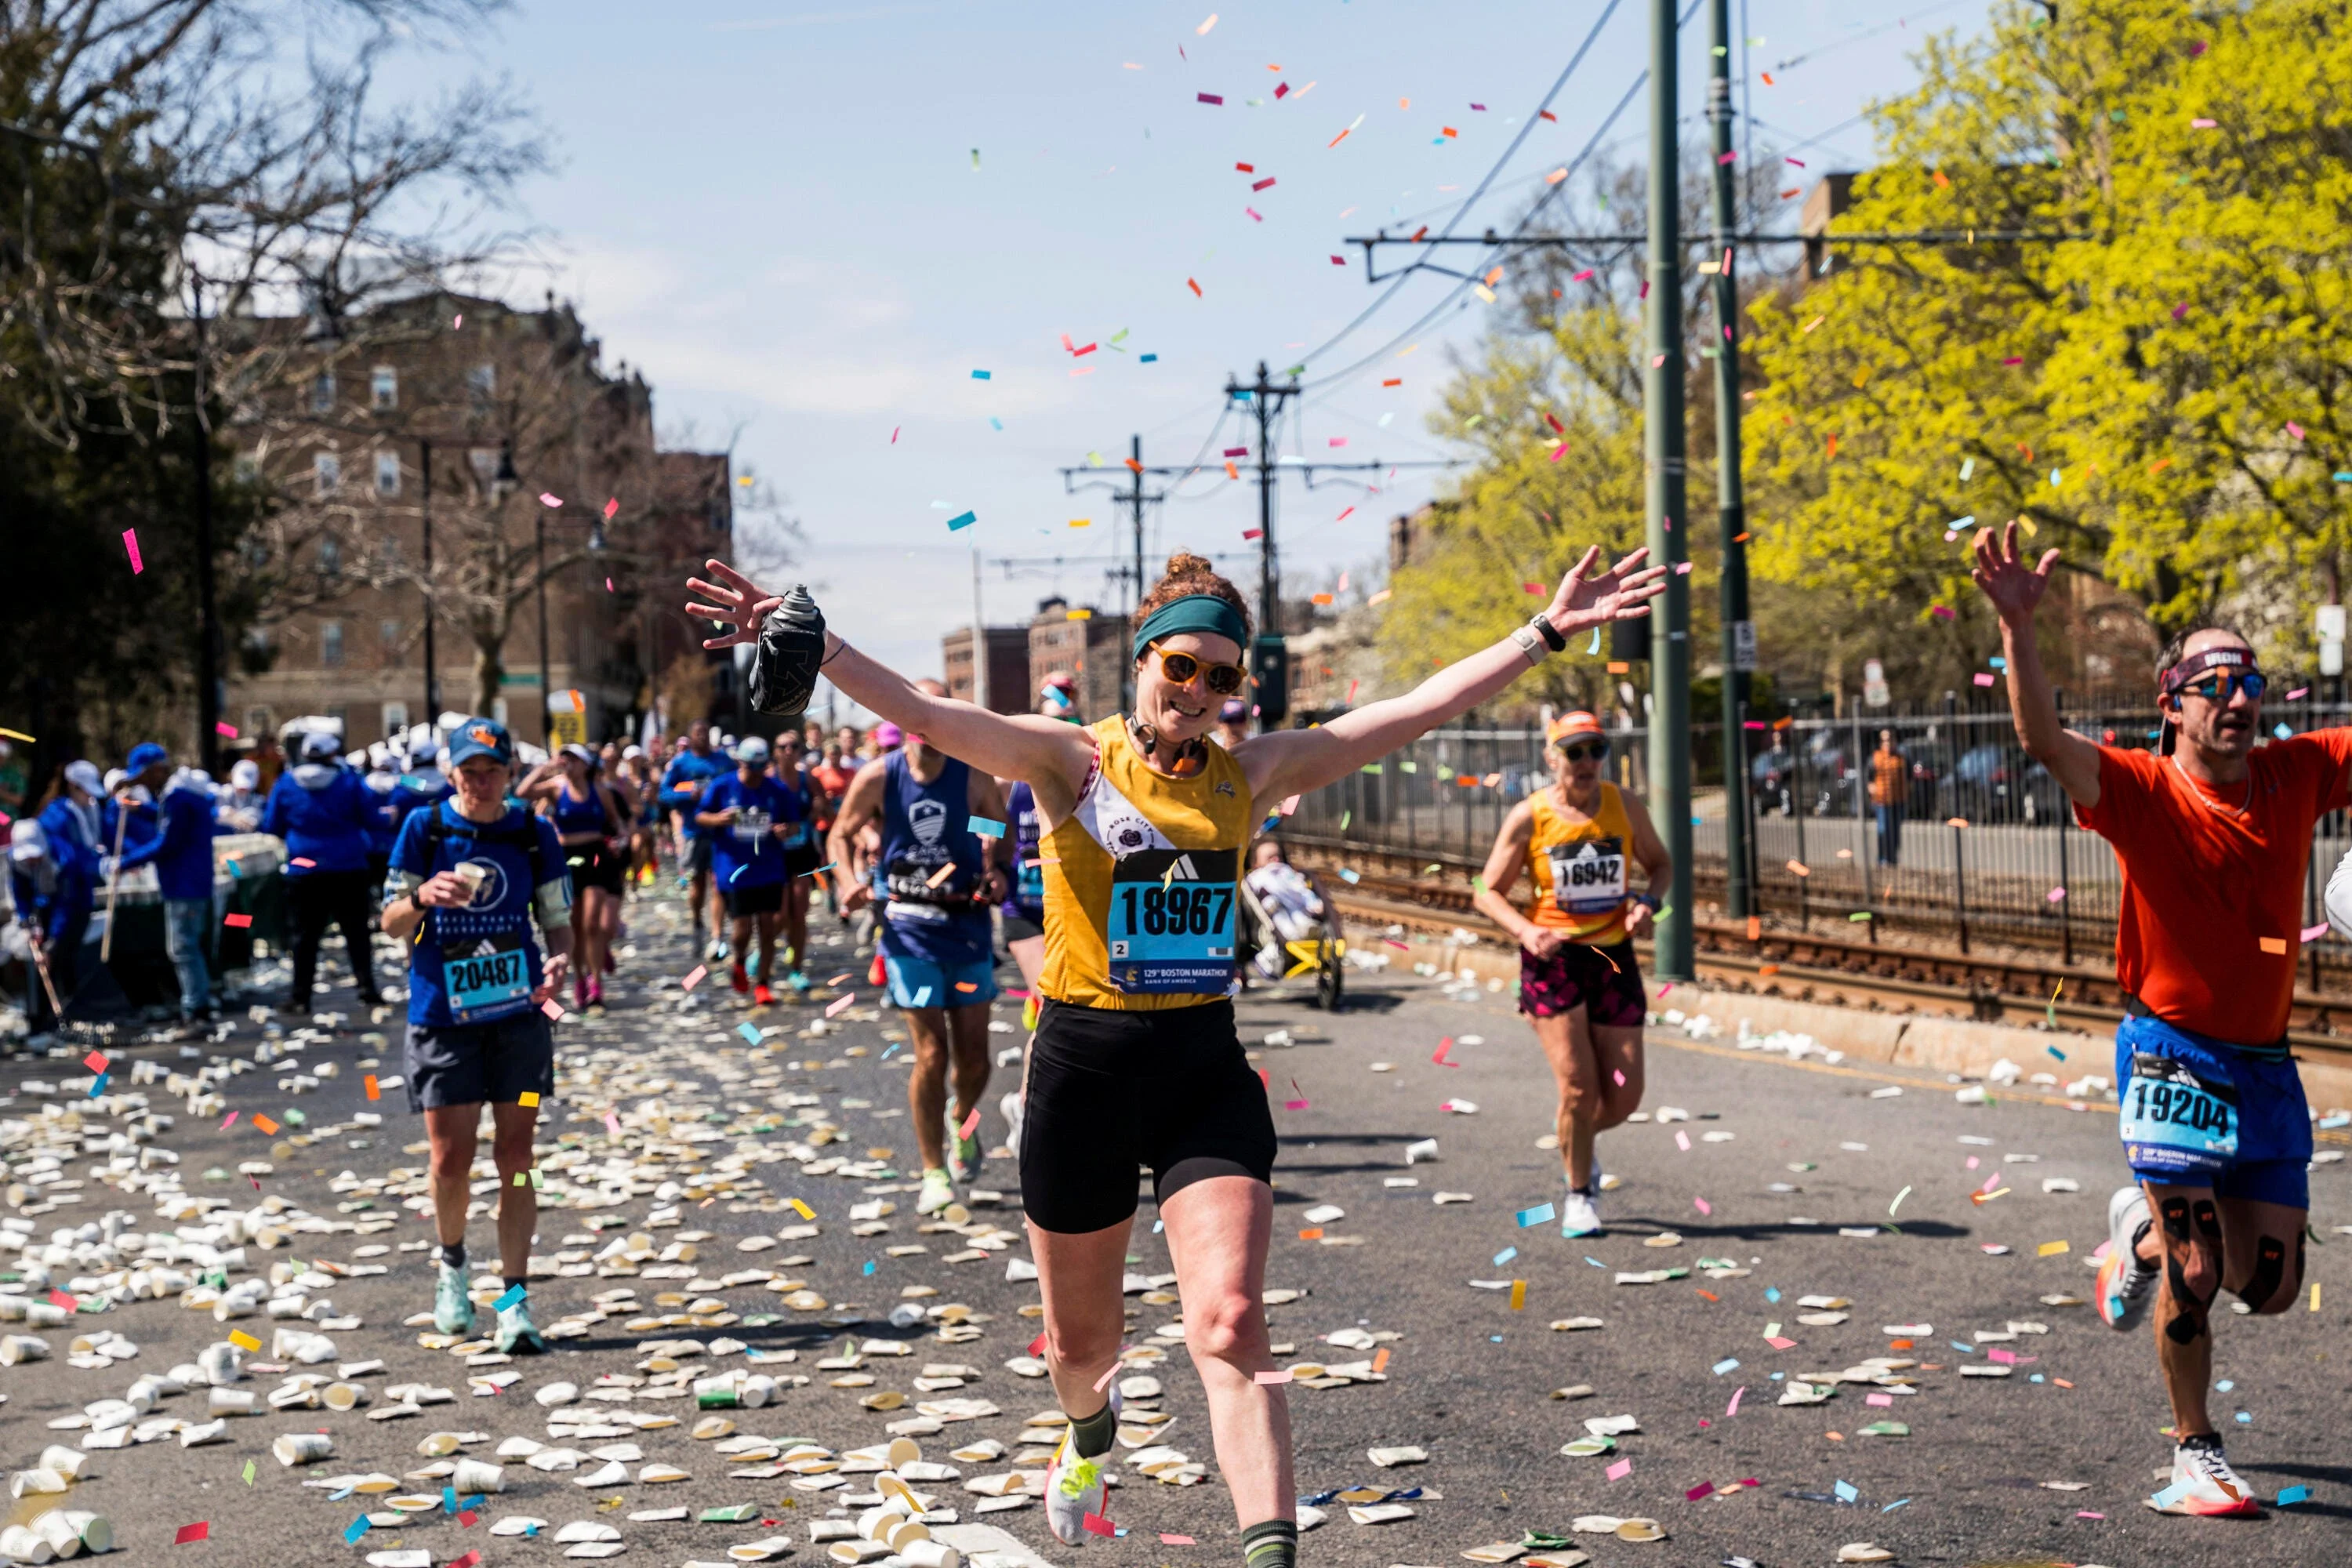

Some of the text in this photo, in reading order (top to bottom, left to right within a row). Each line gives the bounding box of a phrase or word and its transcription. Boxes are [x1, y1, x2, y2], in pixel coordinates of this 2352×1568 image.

[1109, 816, 1153, 832] ROSE CITY
[1563, 859, 1620, 887] 16942
[1121, 886, 1234, 935] 18967
[1116, 944, 1125, 955] 2
[451, 953, 521, 994] 20487
[1161, 968, 1190, 977] BOSTON
[1192, 967, 1228, 977] MARATHON
[2135, 1083, 2230, 1138] 19204
